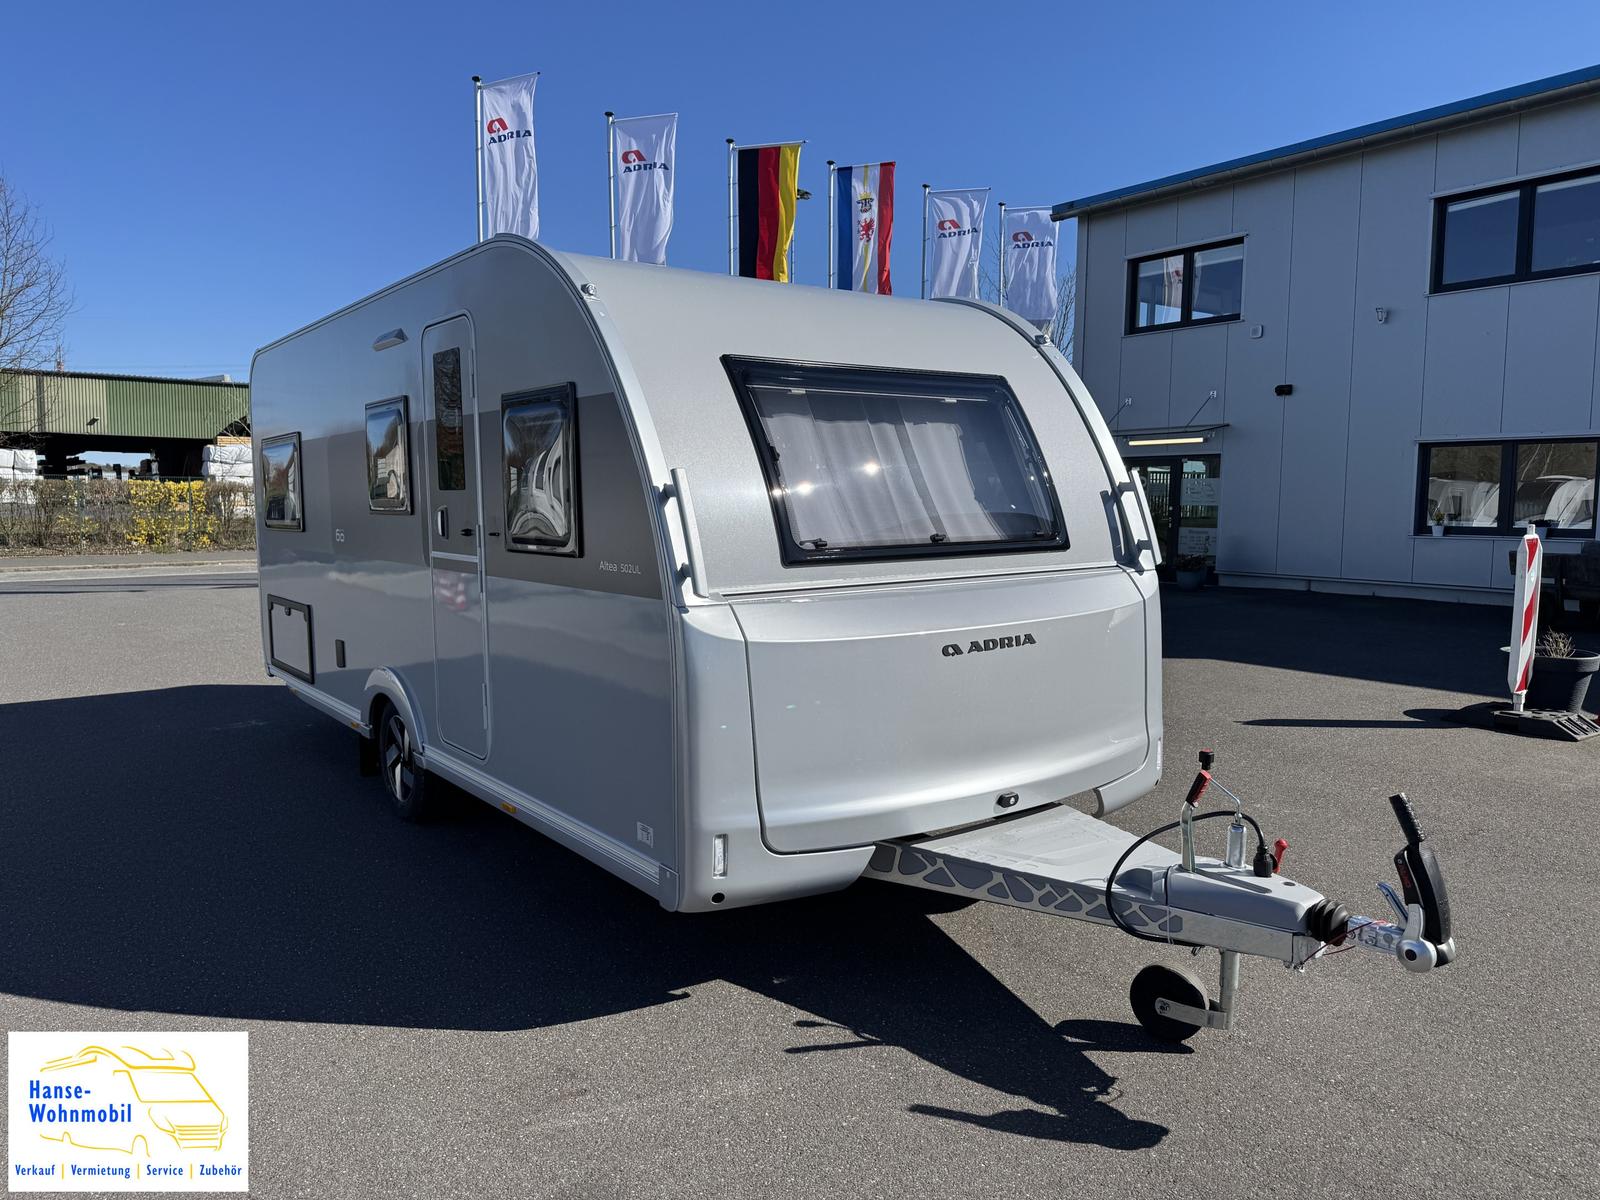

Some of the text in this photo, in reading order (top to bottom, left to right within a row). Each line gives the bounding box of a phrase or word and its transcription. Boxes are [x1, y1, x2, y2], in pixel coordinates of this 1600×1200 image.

[488, 129, 532, 146] ADRIA
[622, 161, 670, 174] ADRIA
[937, 226, 979, 239] ADRIA
[1012, 239, 1054, 250] ADRIA
[599, 560, 642, 575] Altea 502UL
[967, 633, 1037, 654] ADRIA
